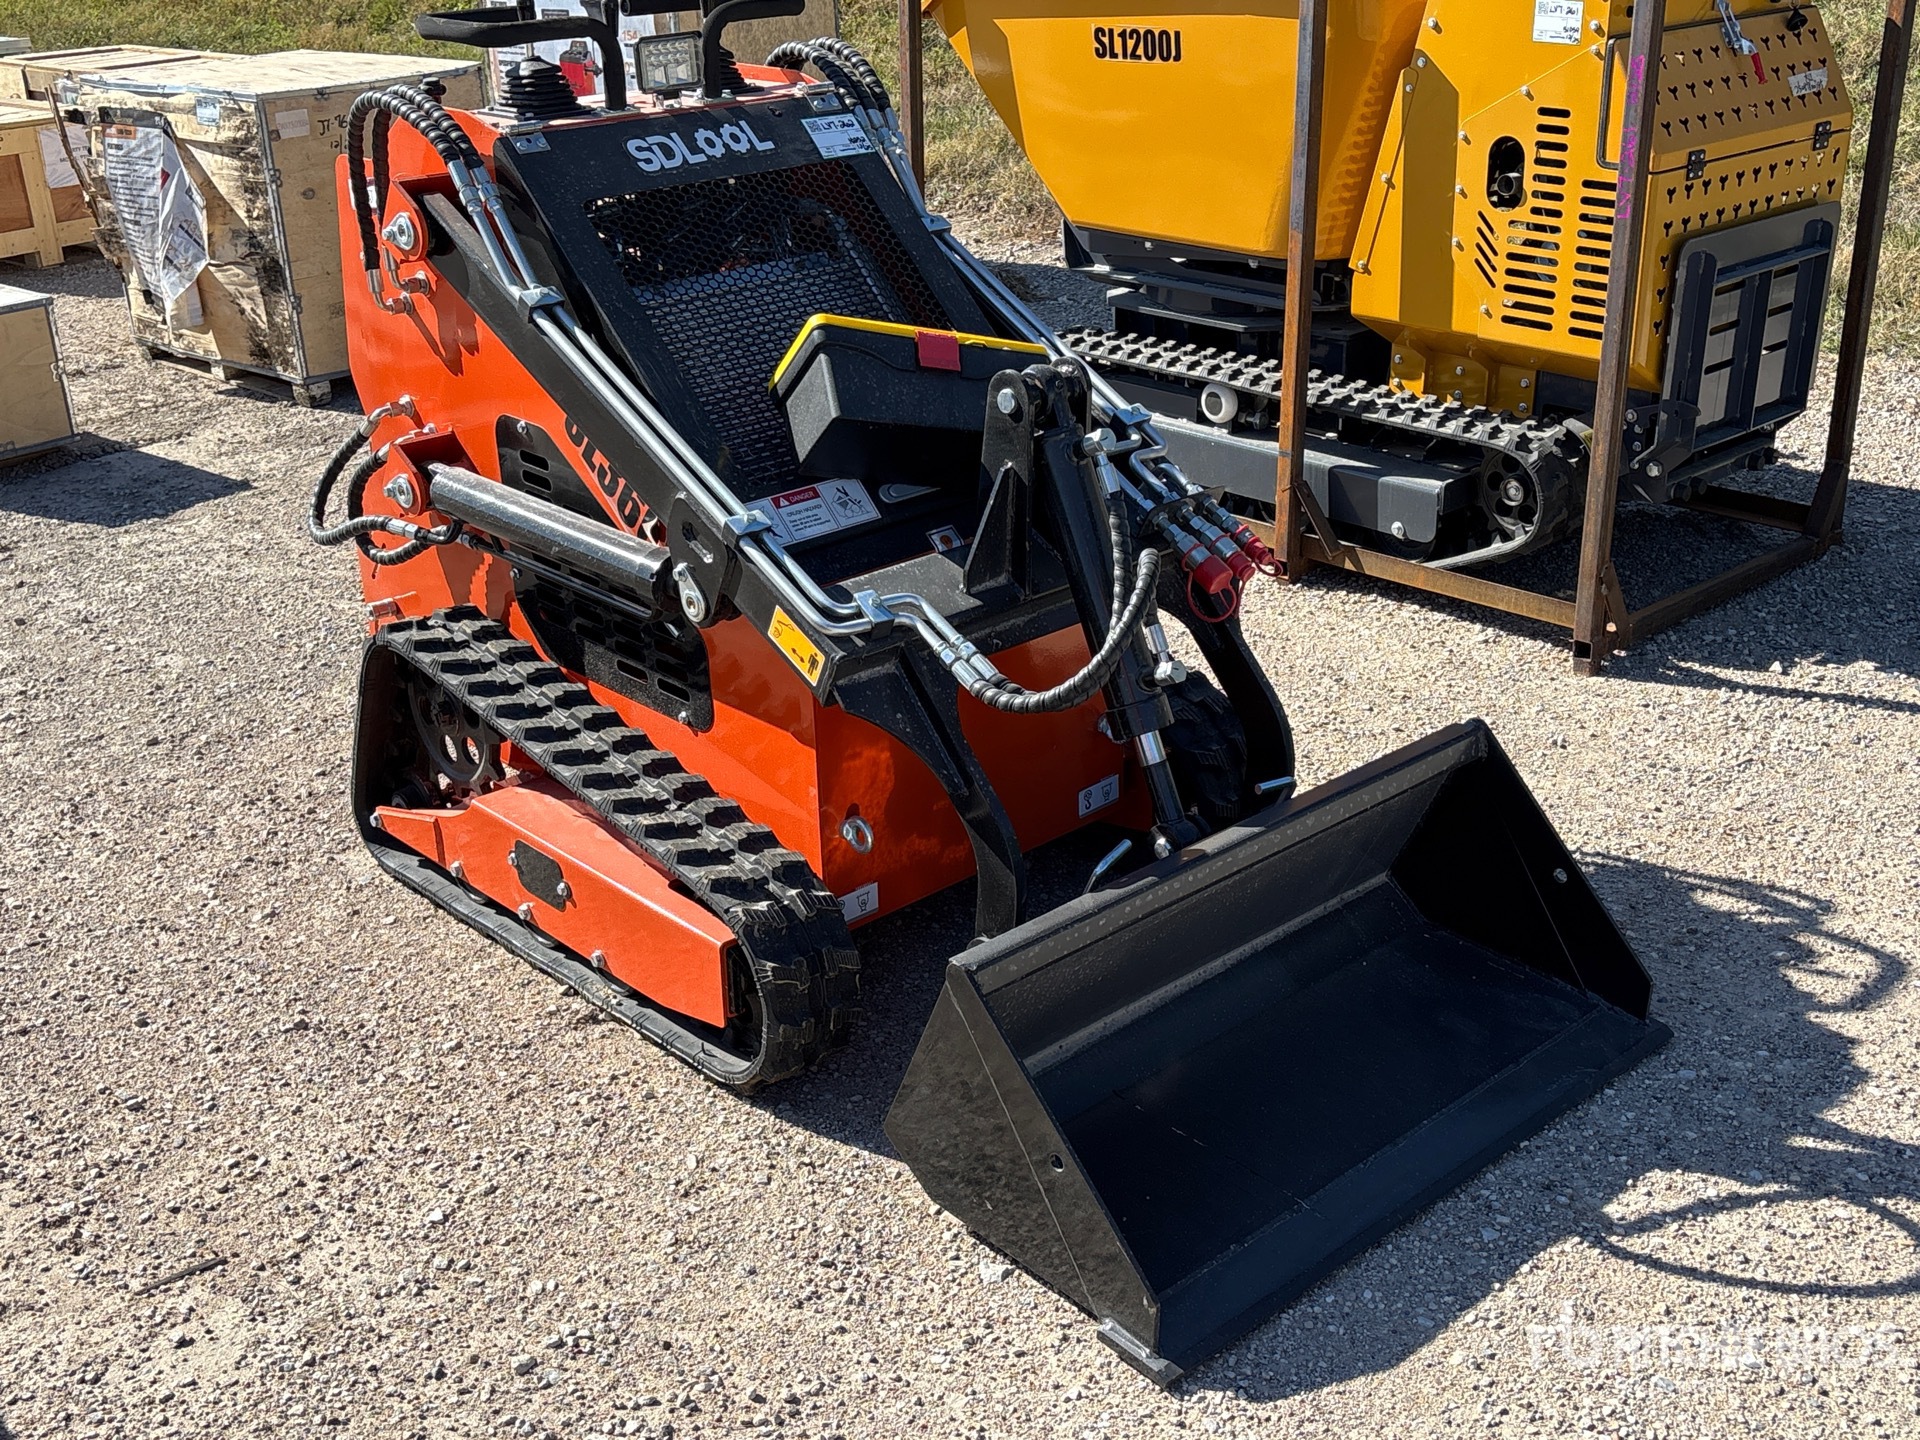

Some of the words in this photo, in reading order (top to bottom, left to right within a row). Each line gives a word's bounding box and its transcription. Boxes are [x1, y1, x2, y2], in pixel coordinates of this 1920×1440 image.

[1093, 26, 1181, 62] SL1200J
[626, 120, 776, 172] SDLOOL
[789, 491, 816, 503] DANGER
